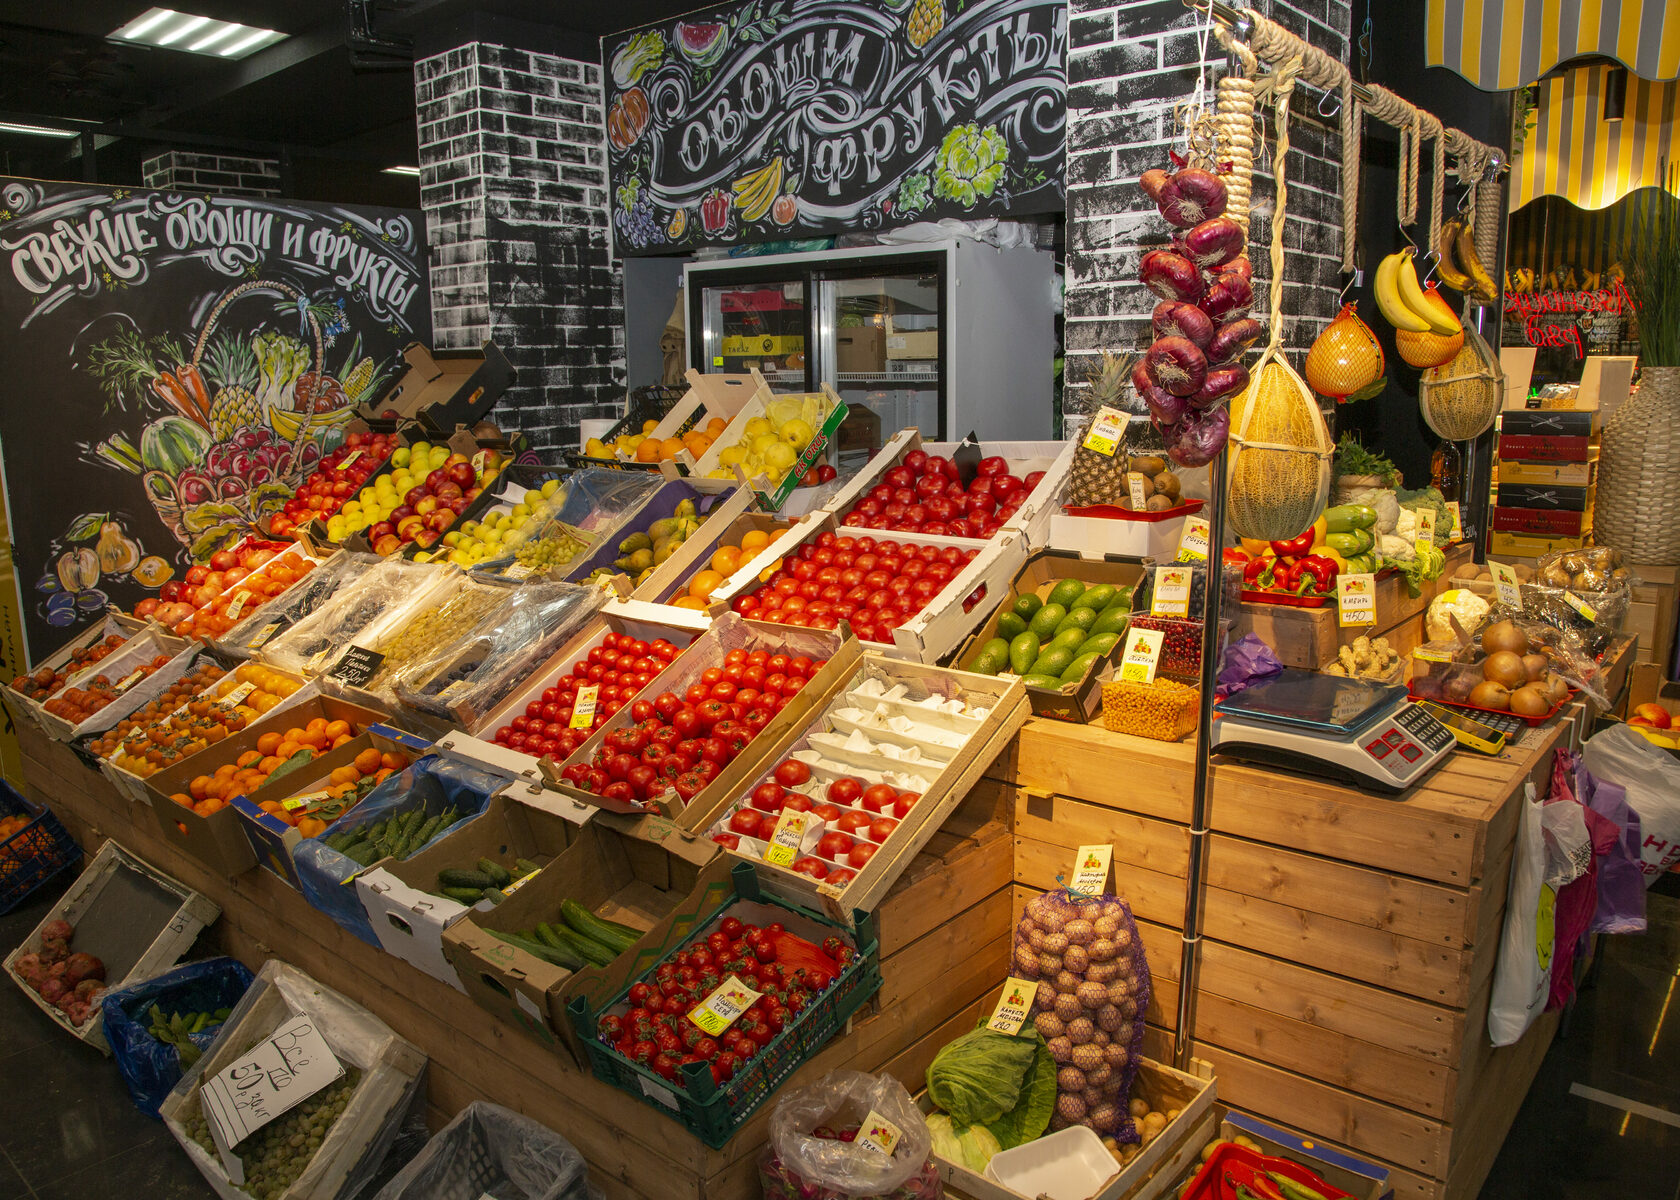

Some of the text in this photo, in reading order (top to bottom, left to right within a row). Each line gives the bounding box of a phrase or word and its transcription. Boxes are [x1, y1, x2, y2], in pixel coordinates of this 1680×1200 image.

[680, 28, 866, 172] ОВОЩИ
[815, 7, 1068, 196] ФРУКТЫ
[3, 196, 420, 322] СВЕЖИЕ ОВОЩИ И ФРУКТЫ
[794, 459, 807, 477] AK
[1345, 610, 1366, 622] 450
